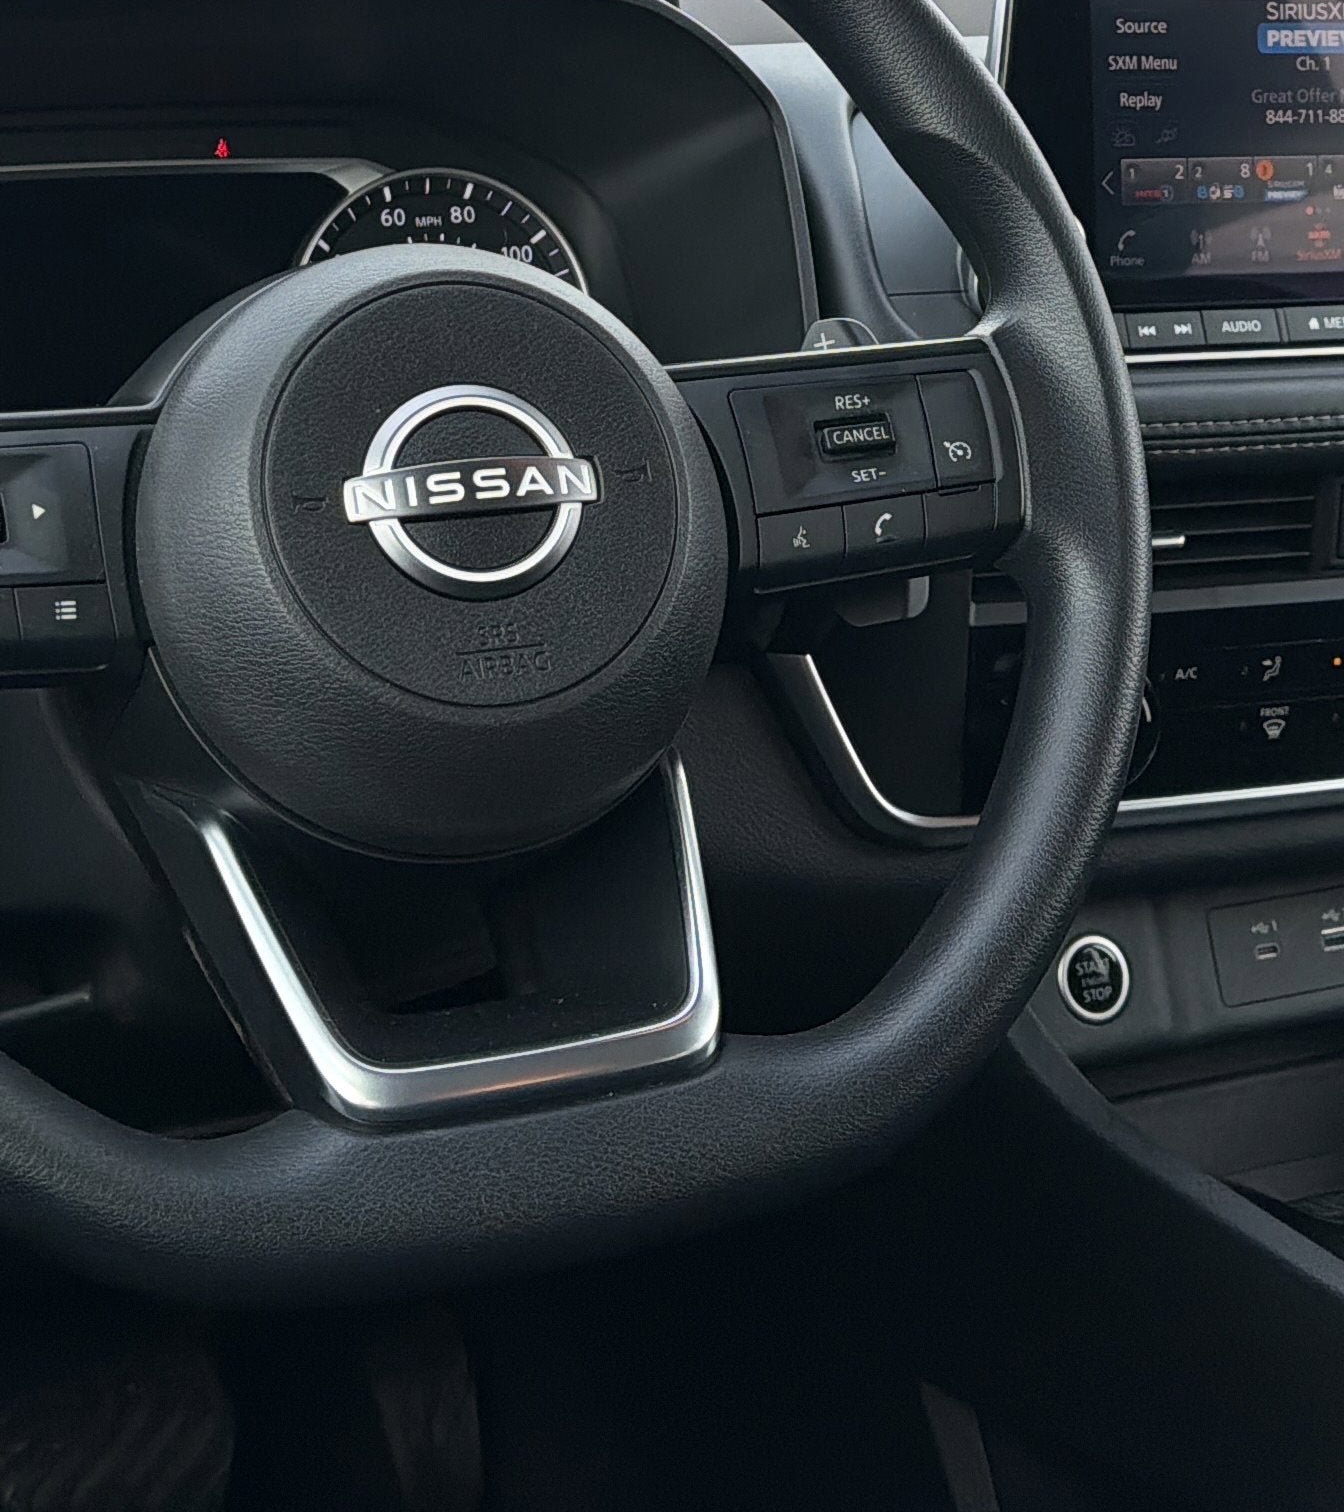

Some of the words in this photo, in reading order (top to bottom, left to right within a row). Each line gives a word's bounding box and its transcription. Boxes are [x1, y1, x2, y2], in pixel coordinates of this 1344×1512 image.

[1115, 17, 1168, 35] Source
[1108, 54, 1145, 71] SXM
[1147, 54, 1178, 71] Menu
[1296, 55, 1320, 72] Ch.
[1322, 56, 1331, 71] 1
[1119, 91, 1163, 111] Replay
[1251, 88, 1294, 105] Great
[1297, 87, 1337, 104] Offer
[1174, 165, 1185, 180] 2
[1194, 166, 1203, 178] 2
[1240, 162, 1252, 179] 8
[1306, 162, 1314, 177] 1
[1325, 164, 1333, 175] 4
[380, 207, 407, 227] 60
[415, 215, 443, 228] MPH
[449, 205, 476, 225] 80
[1109, 254, 1145, 268] Phone
[1192, 252, 1212, 265] AM
[1221, 318, 1262, 334] AUDIO
[834, 394, 871, 411] RES+
[832, 424, 891, 446] CANCEL
[353, 464, 595, 516] NISSAN
[1174, 666, 1199, 681] A/C
[1260, 704, 1290, 718] FRONT
[1083, 986, 1113, 1004] STOP
